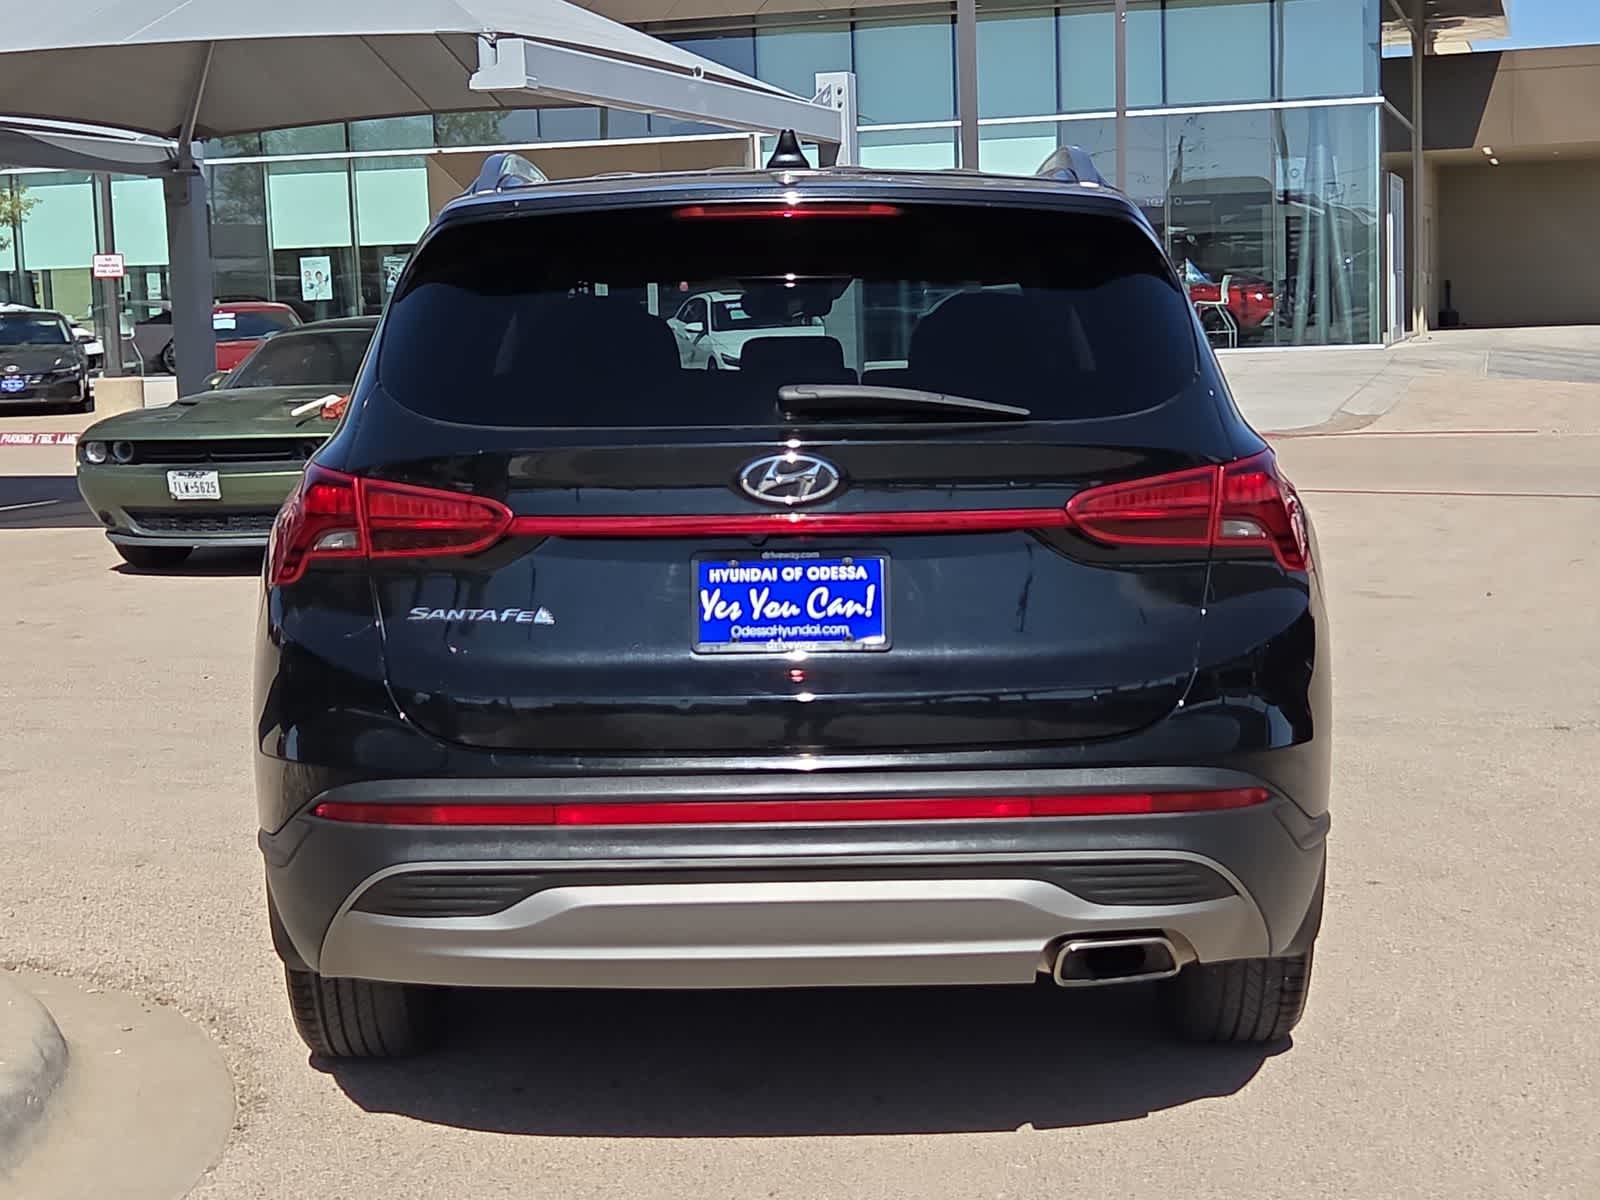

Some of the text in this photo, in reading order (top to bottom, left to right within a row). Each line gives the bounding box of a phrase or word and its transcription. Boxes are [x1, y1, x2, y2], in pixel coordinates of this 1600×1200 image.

[708, 565, 868, 584] HYUNDAI OF ODESSA
[700, 584, 876, 622] Yes You Can!
[407, 606, 535, 622] SANTA FE
[730, 624, 850, 640] OdessaHyundai.com
